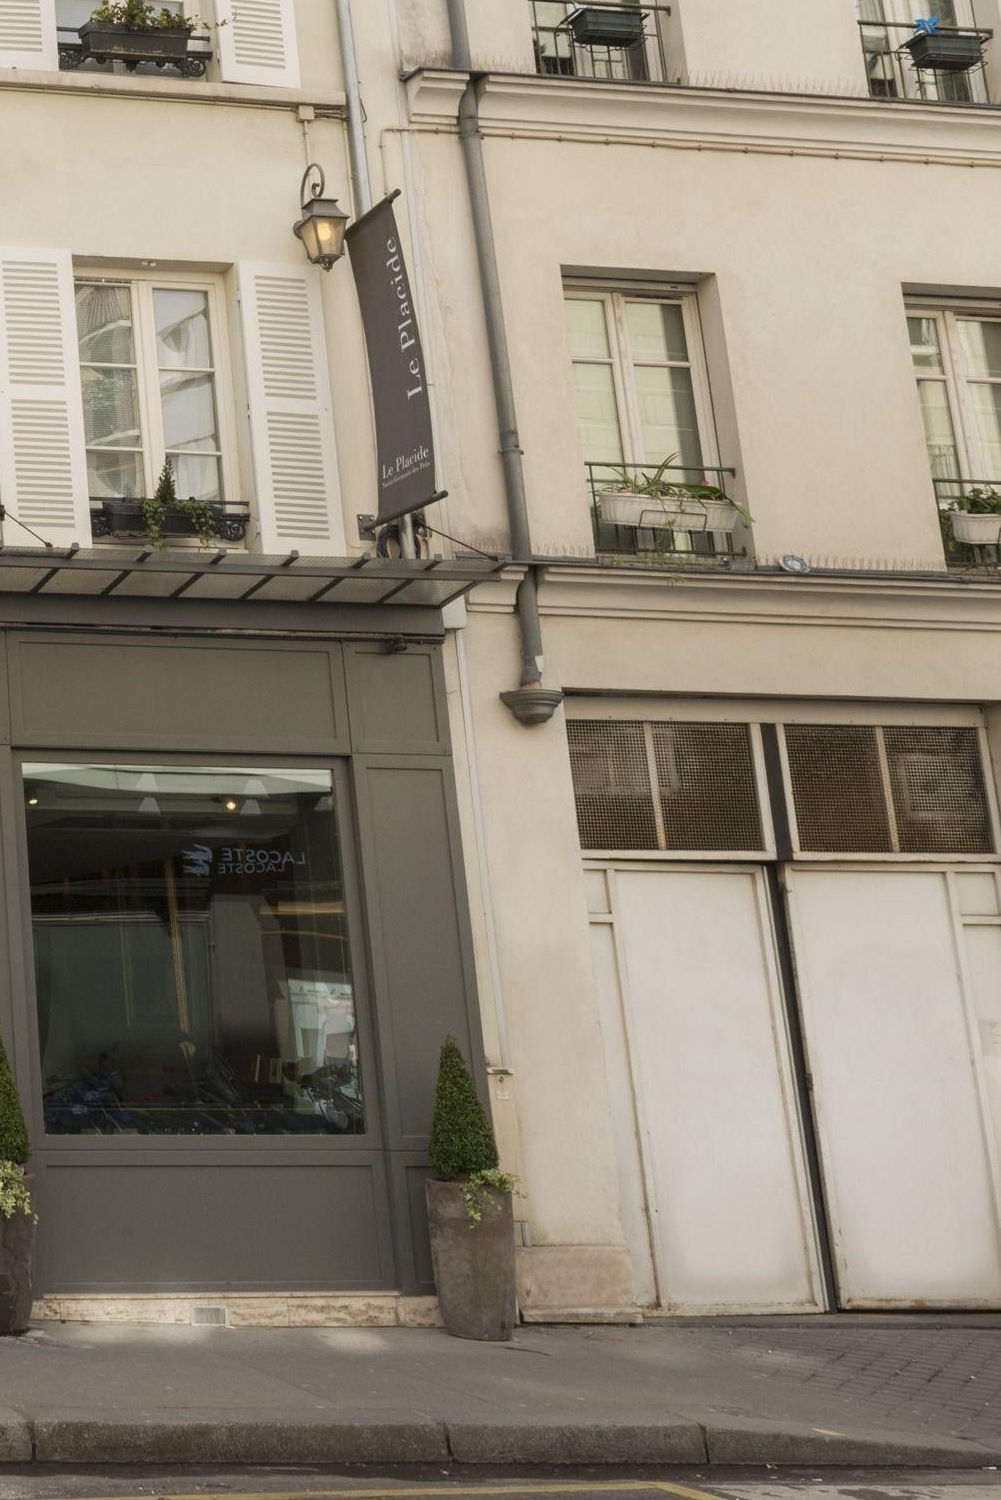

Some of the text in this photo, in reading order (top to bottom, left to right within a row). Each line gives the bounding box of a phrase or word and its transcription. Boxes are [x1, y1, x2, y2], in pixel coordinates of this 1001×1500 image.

[386, 236, 423, 400] Le Placide
[382, 445, 429, 479] Le Placide
